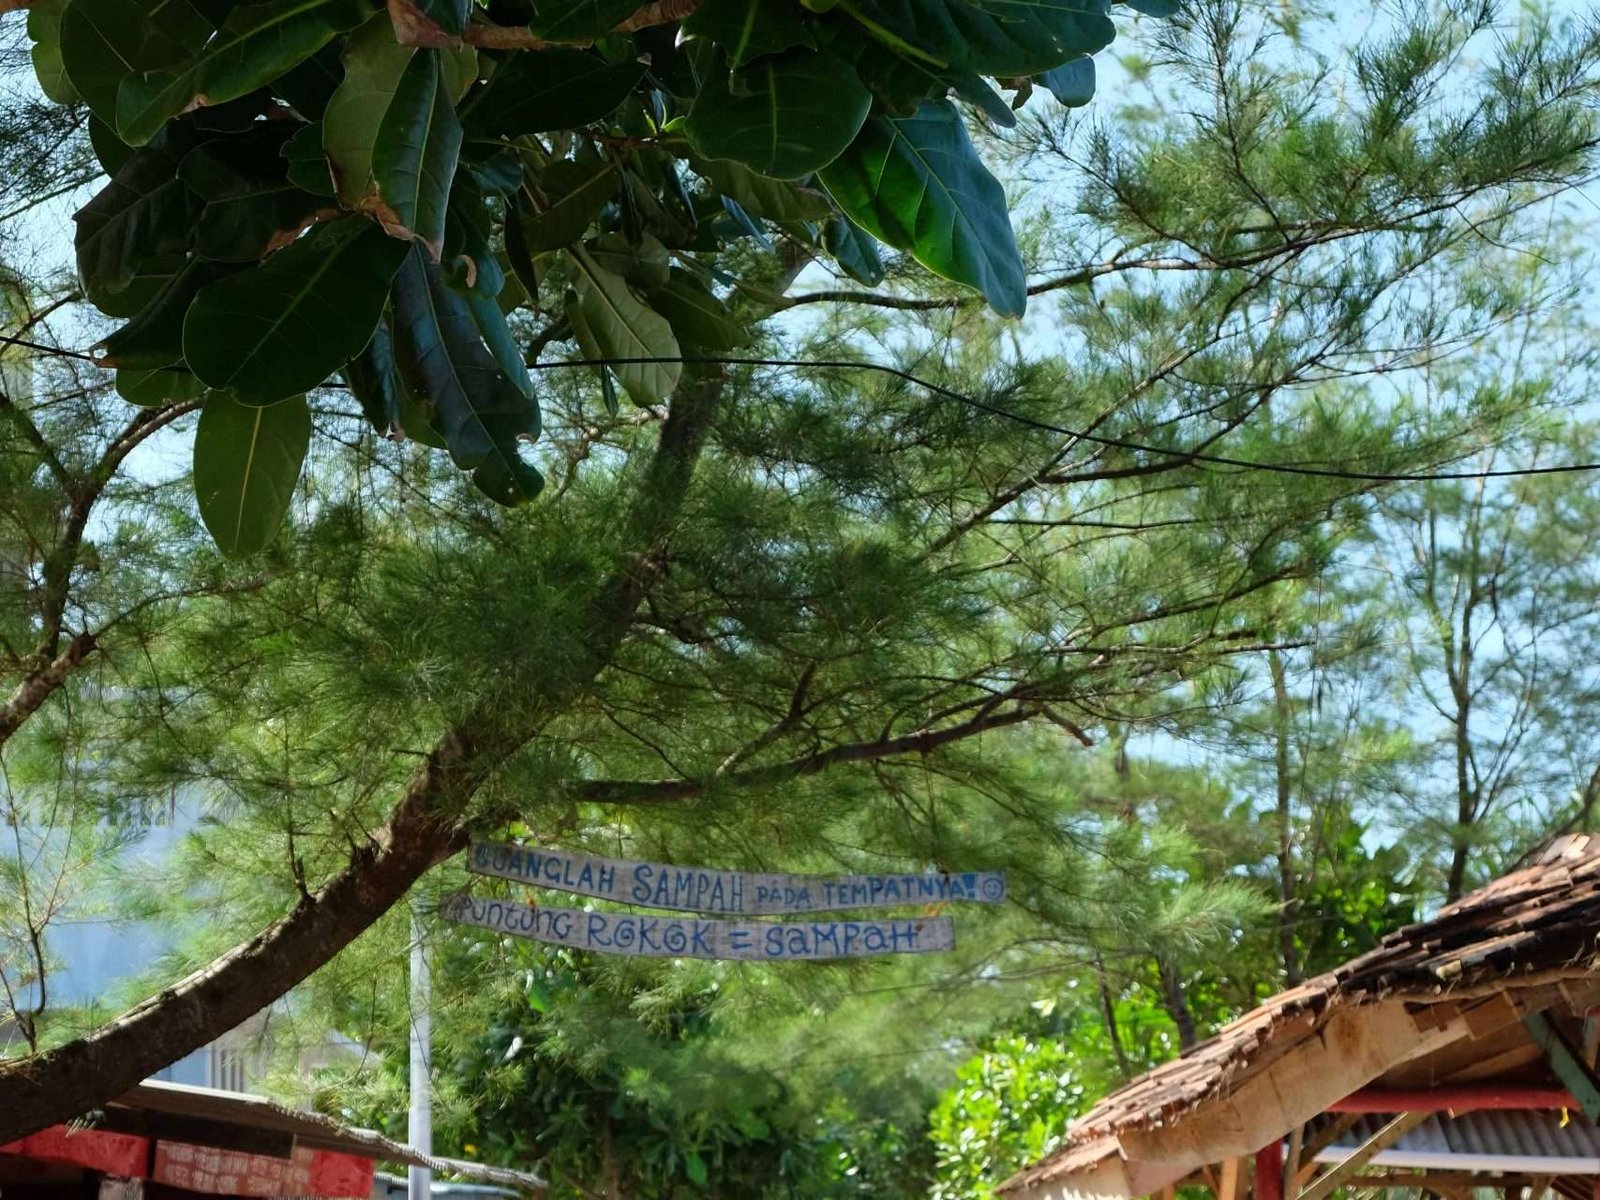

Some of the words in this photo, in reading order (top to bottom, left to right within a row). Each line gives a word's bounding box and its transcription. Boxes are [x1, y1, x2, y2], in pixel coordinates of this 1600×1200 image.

[475, 845, 616, 893] BUANGLAH
[632, 865, 745, 912] SAMPAH
[756, 879, 812, 909] PADA
[822, 873, 977, 905] TEMPATNYA!
[728, 931, 752, 950] =
